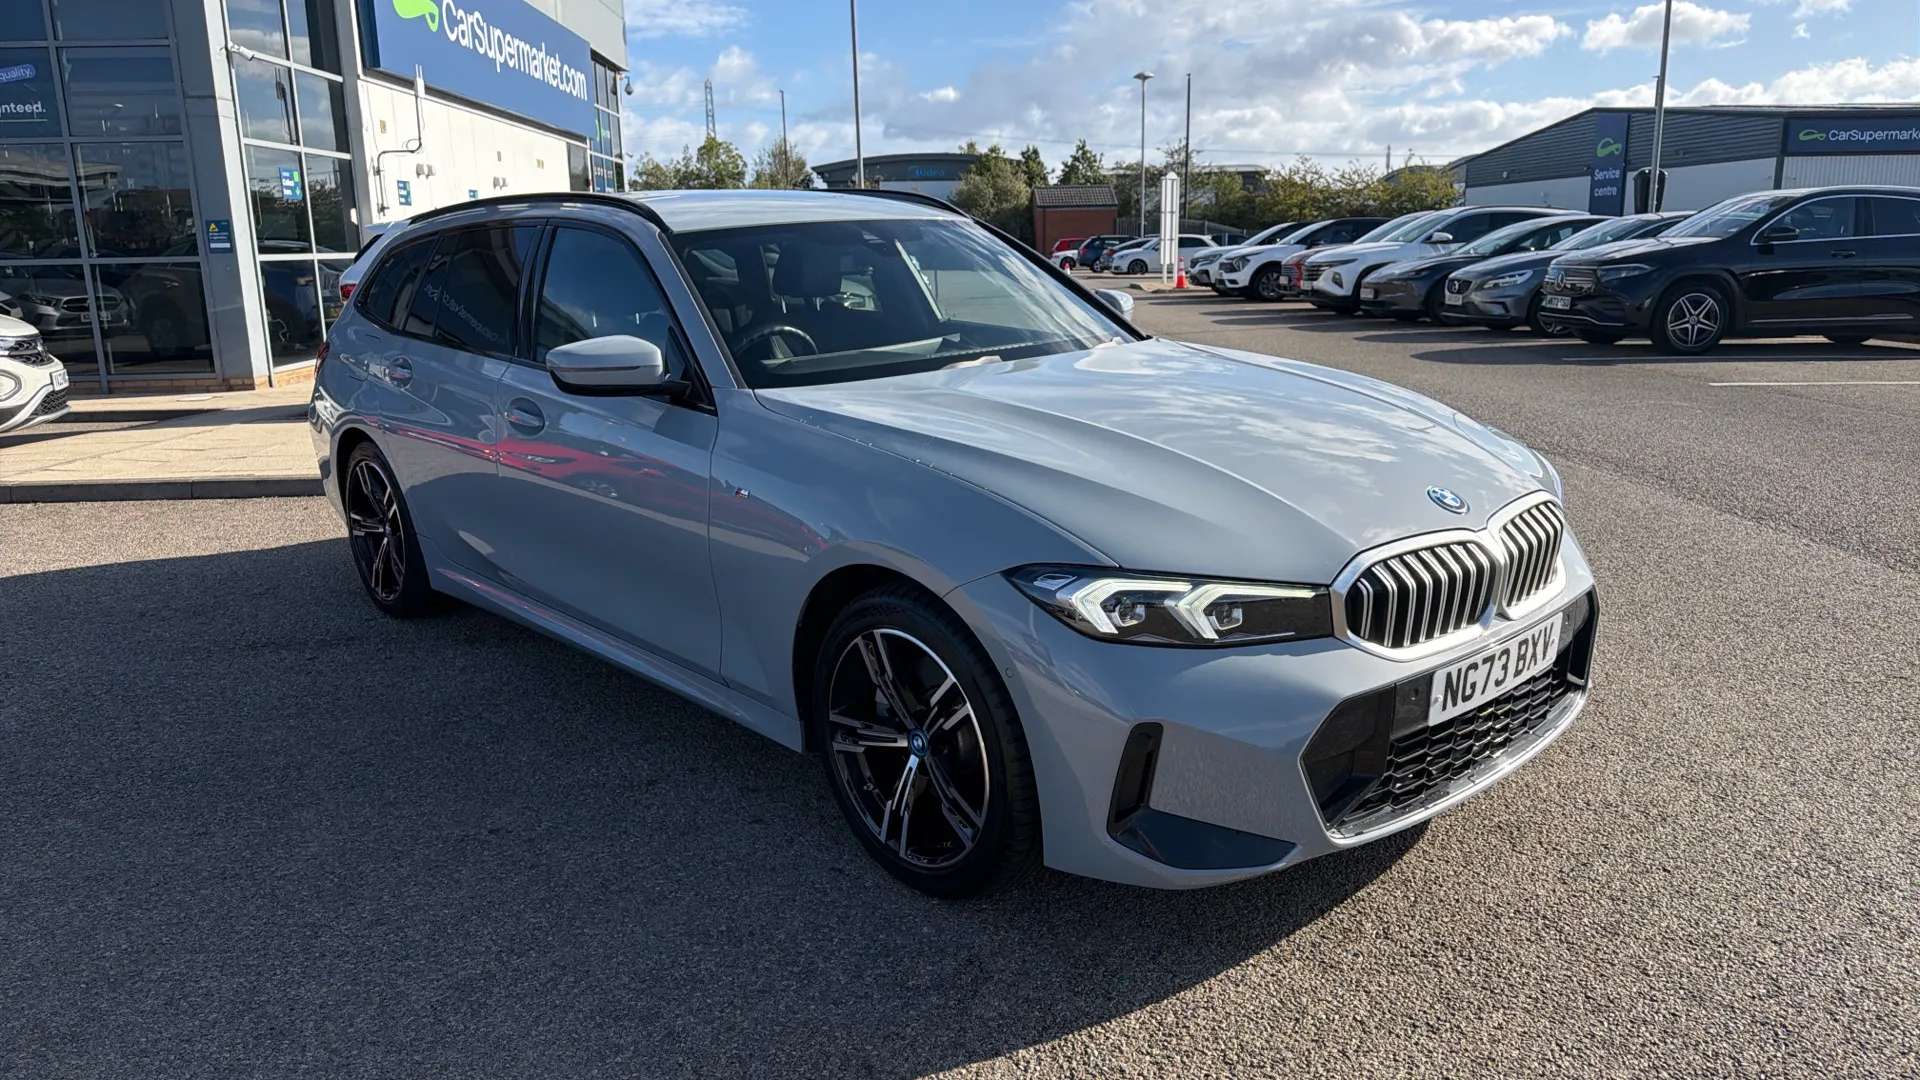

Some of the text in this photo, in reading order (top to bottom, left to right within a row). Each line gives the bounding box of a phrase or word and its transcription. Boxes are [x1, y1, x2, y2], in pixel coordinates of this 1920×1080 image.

[442, 0, 588, 101] CarSupermarket.com
[0, 101, 46, 113] nteed.
[1828, 127, 1920, 143] CarSupermark
[1594, 168, 1620, 180] Service
[1594, 186, 1617, 197] centre
[1442, 622, 1554, 711] NG73 BXV
